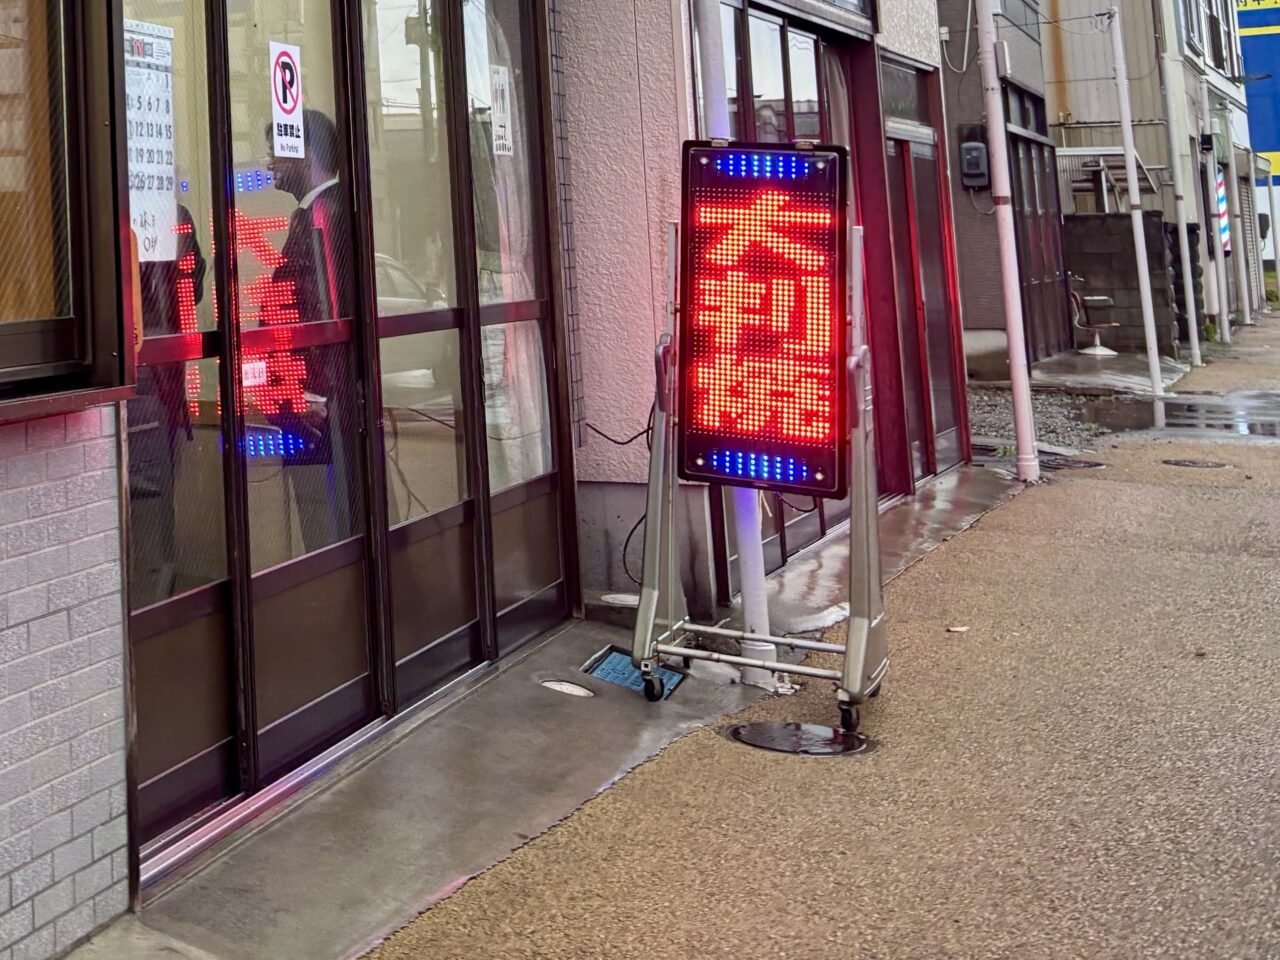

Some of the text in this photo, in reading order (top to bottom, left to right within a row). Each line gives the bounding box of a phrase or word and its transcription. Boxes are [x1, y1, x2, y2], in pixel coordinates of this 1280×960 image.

[137, 96, 142, 110] 5
[147, 97, 153, 112] 6
[155, 98, 160, 113] 7
[135, 121, 144, 137] 12
[146, 122, 154, 138] 13
[155, 123, 163, 139] 14
[165, 124, 172, 140] 15
[276, 122, 301, 138] 駐車禁止
[135, 147, 144, 163] 19
[146, 148, 155, 164] 20
[156, 149, 163, 165] 21
[165, 150, 173, 165] 22
[147, 175, 155, 190] 27
[696, 189, 833, 439] 大判焼
